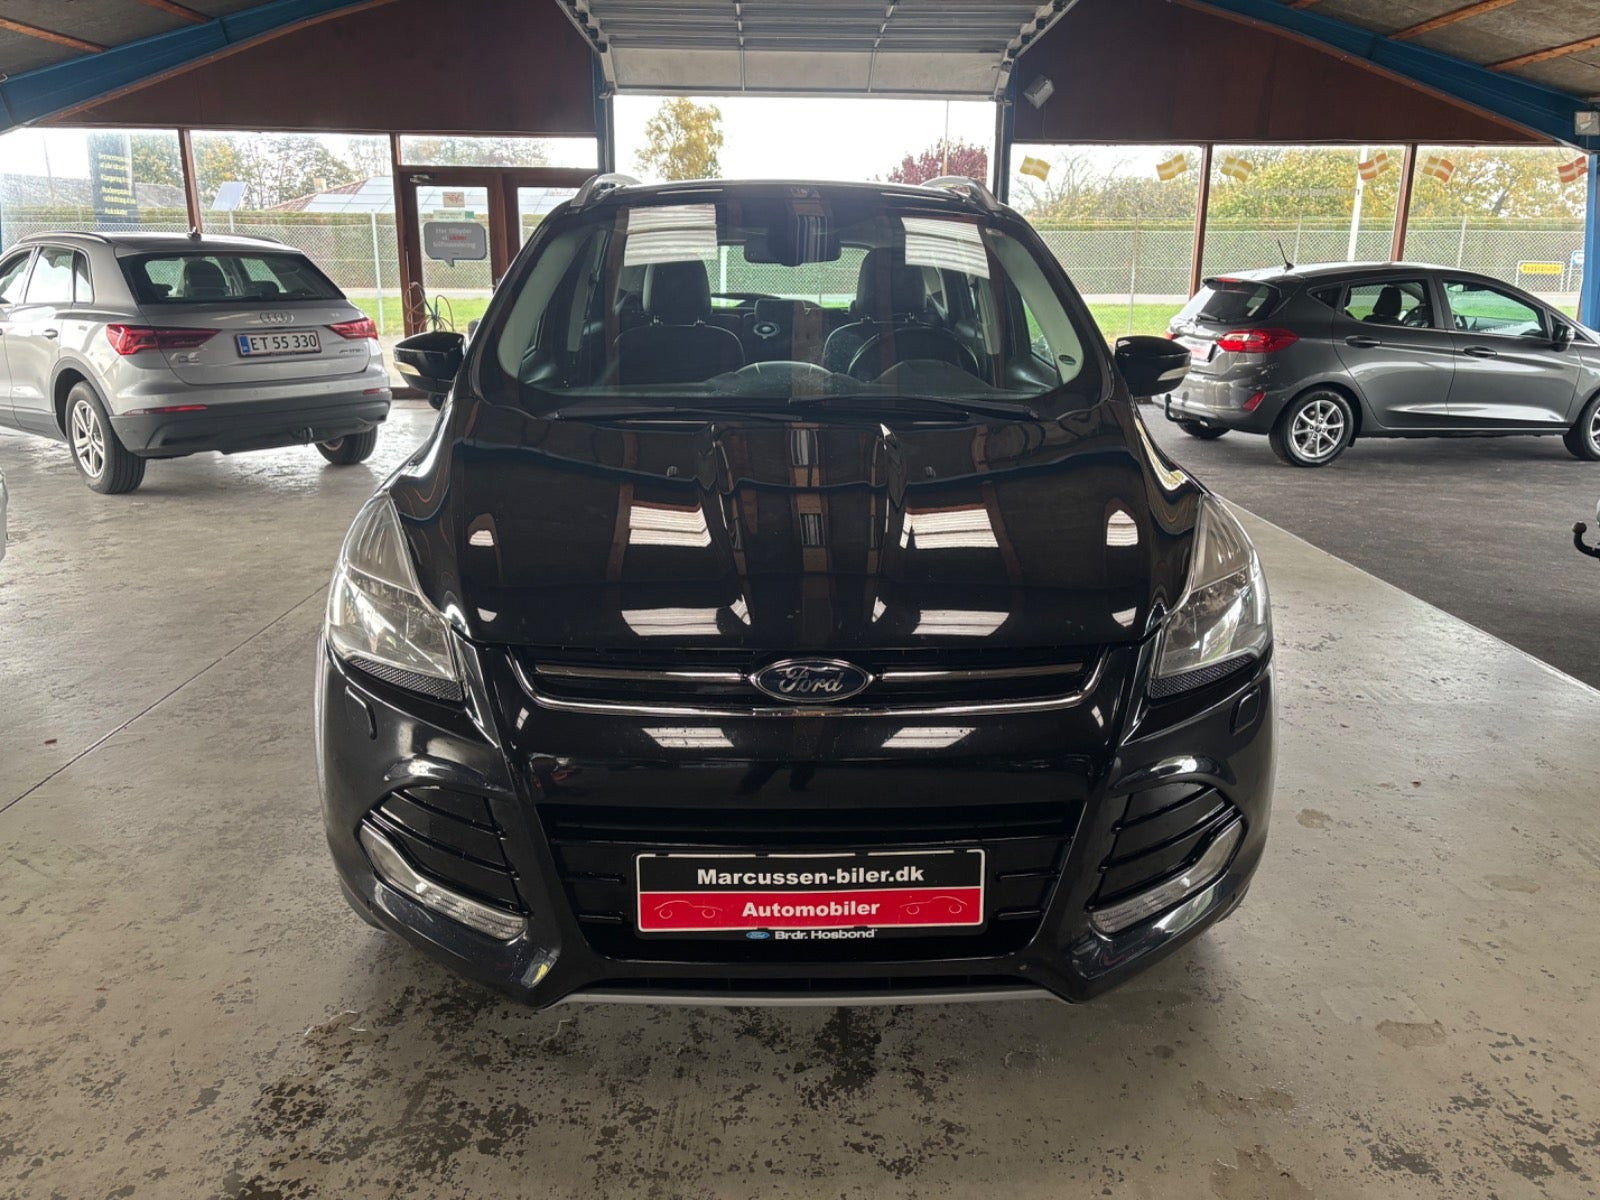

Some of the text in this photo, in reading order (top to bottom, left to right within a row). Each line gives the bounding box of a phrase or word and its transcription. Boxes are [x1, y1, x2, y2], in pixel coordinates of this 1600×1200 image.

[250, 334, 317, 351] ET 55 330
[776, 666, 844, 693] Ford
[696, 866, 925, 886] Marcussen-biler.dk
[742, 900, 881, 918] Automobiler
[774, 930, 808, 940] Brdr.
[811, 929, 876, 940] Hosbond
